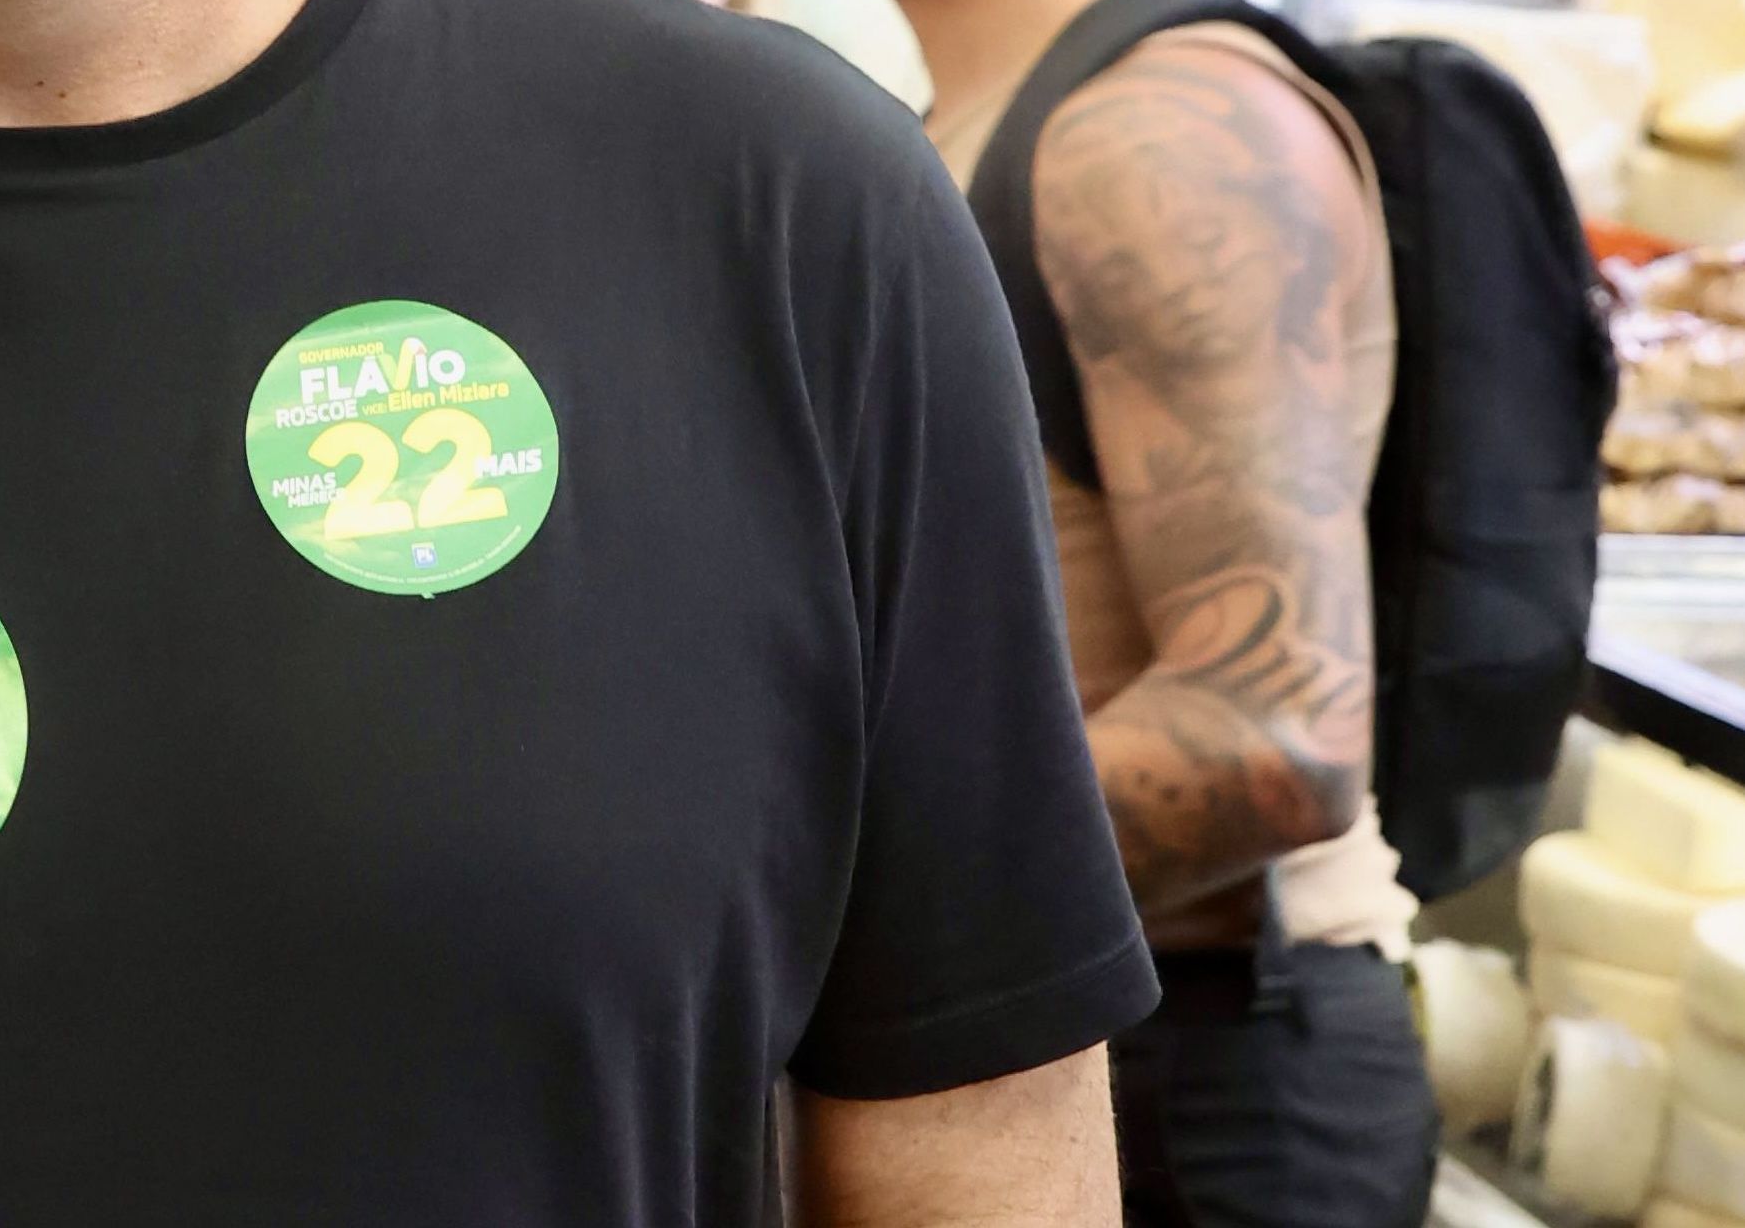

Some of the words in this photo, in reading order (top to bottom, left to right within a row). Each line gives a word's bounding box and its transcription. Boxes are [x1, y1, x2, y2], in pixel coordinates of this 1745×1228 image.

[298, 342, 384, 365] GOVERNADOR
[275, 399, 359, 429] ROSCOE
[307, 408, 508, 541] 22
[474, 448, 543, 479] MAIS
[272, 472, 337, 498] MINAS
